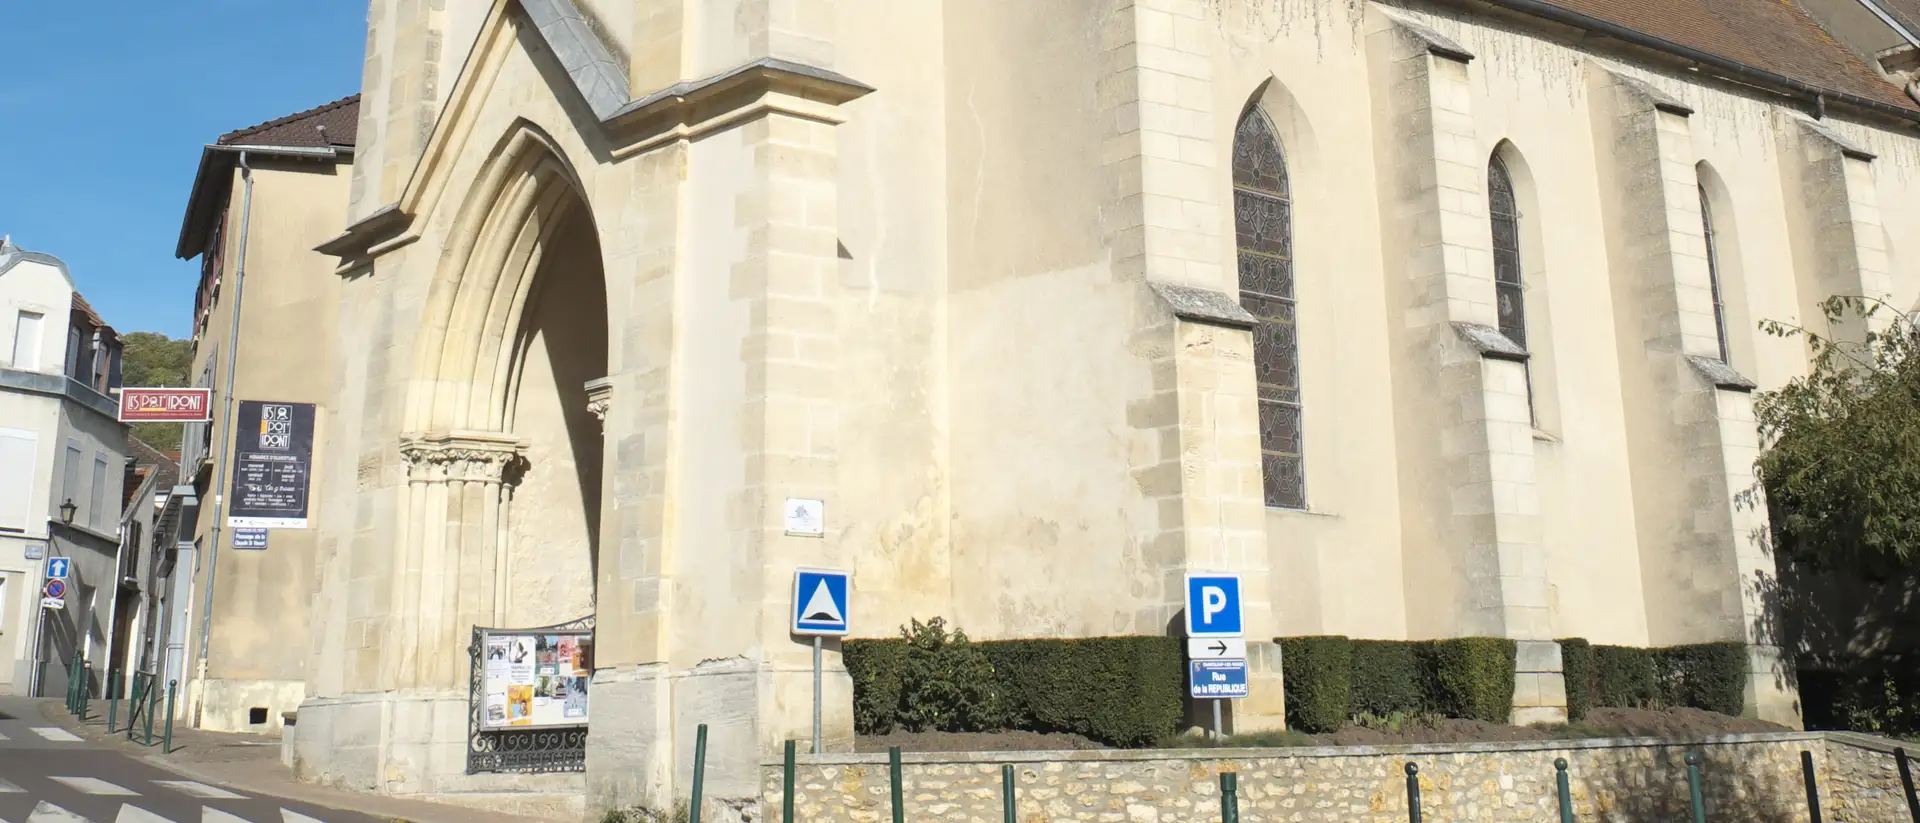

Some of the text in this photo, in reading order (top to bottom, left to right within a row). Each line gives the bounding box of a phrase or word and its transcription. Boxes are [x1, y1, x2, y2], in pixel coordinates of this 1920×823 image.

[167, 395, 201, 410] IRONT
[1202, 586, 1226, 624] P
[1212, 672, 1226, 681] Rue
[1193, 684, 1201, 693] de
[1201, 684, 1208, 693] la
